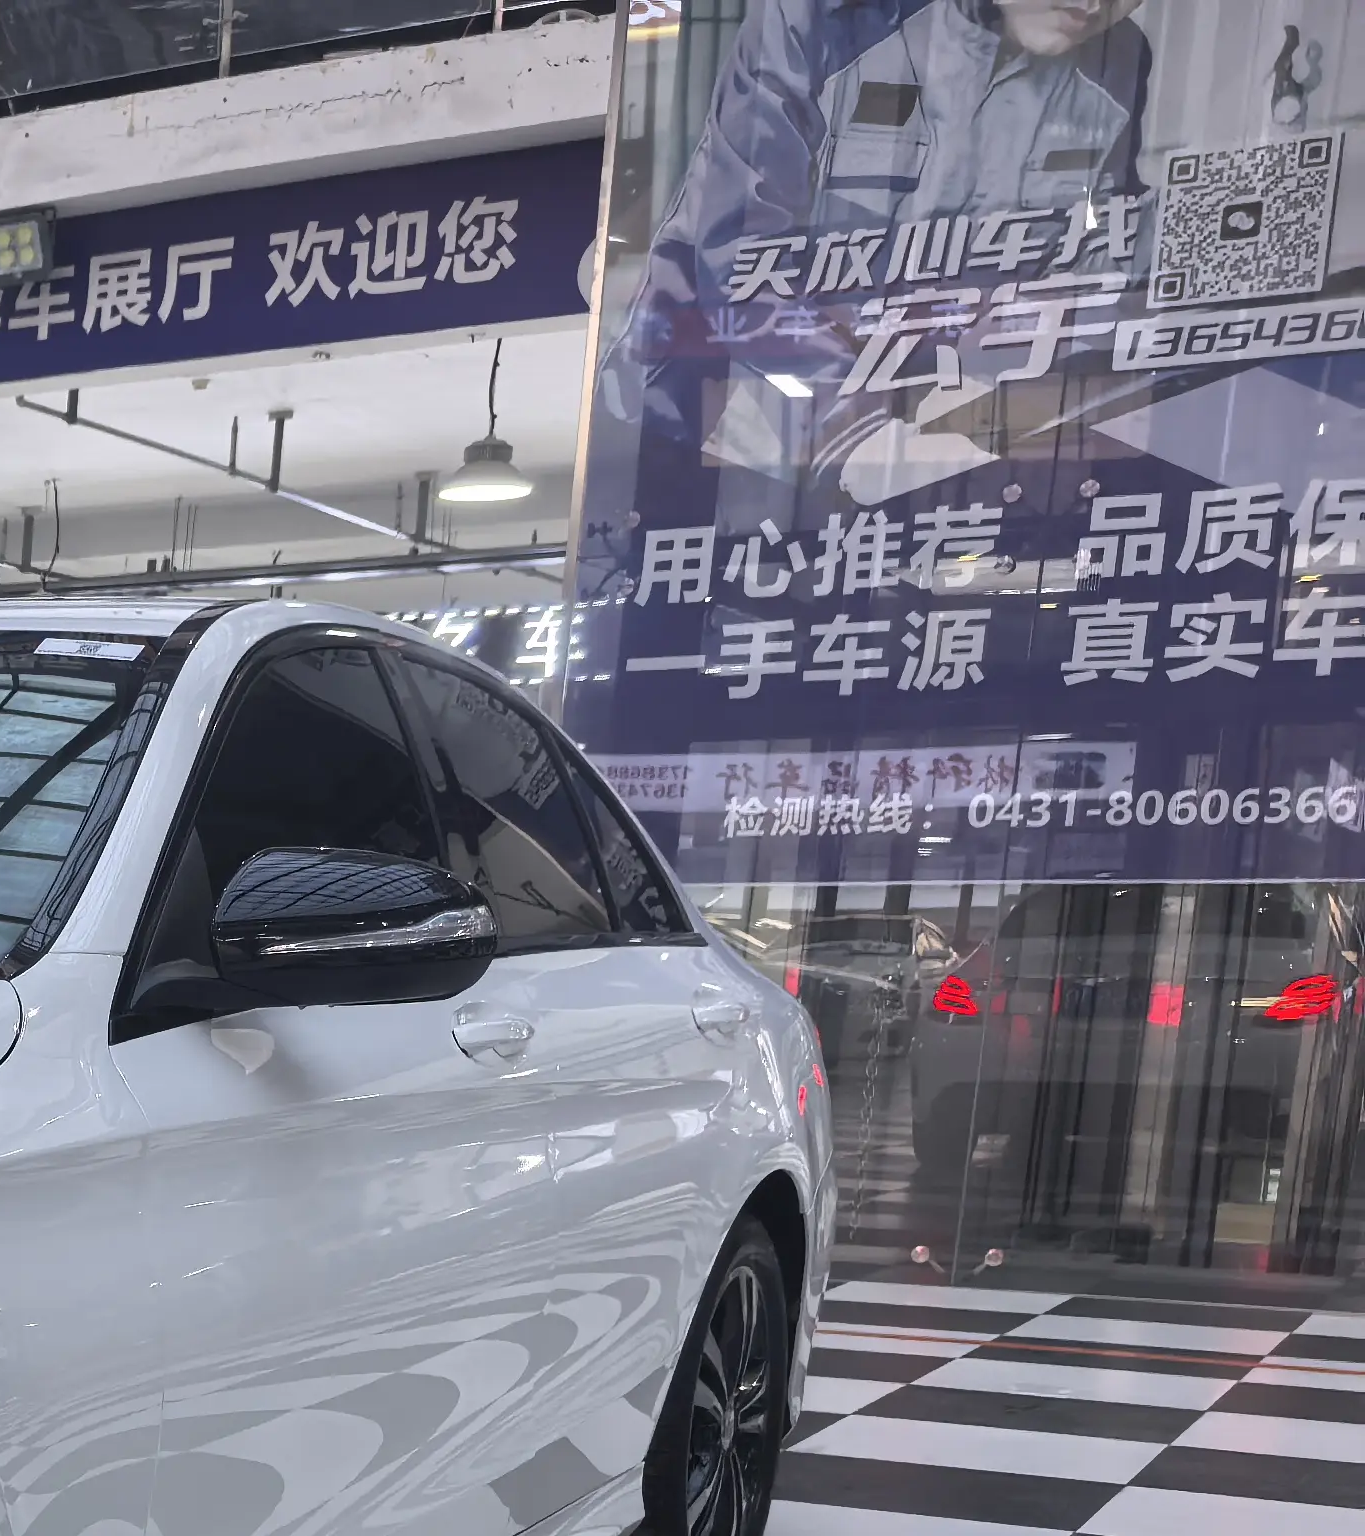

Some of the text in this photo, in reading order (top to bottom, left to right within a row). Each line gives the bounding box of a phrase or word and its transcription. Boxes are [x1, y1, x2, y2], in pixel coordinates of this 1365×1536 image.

[265, 196, 519, 307] 欢迎您
[729, 195, 1140, 302] 买放心车找
[1127, 309, 1365, 361] 1365436
[634, 478, 1365, 607] 用心推荐 品质保
[626, 592, 1365, 699] 一手车源 真实车
[968, 786, 1358, 830] 0431-80606366
